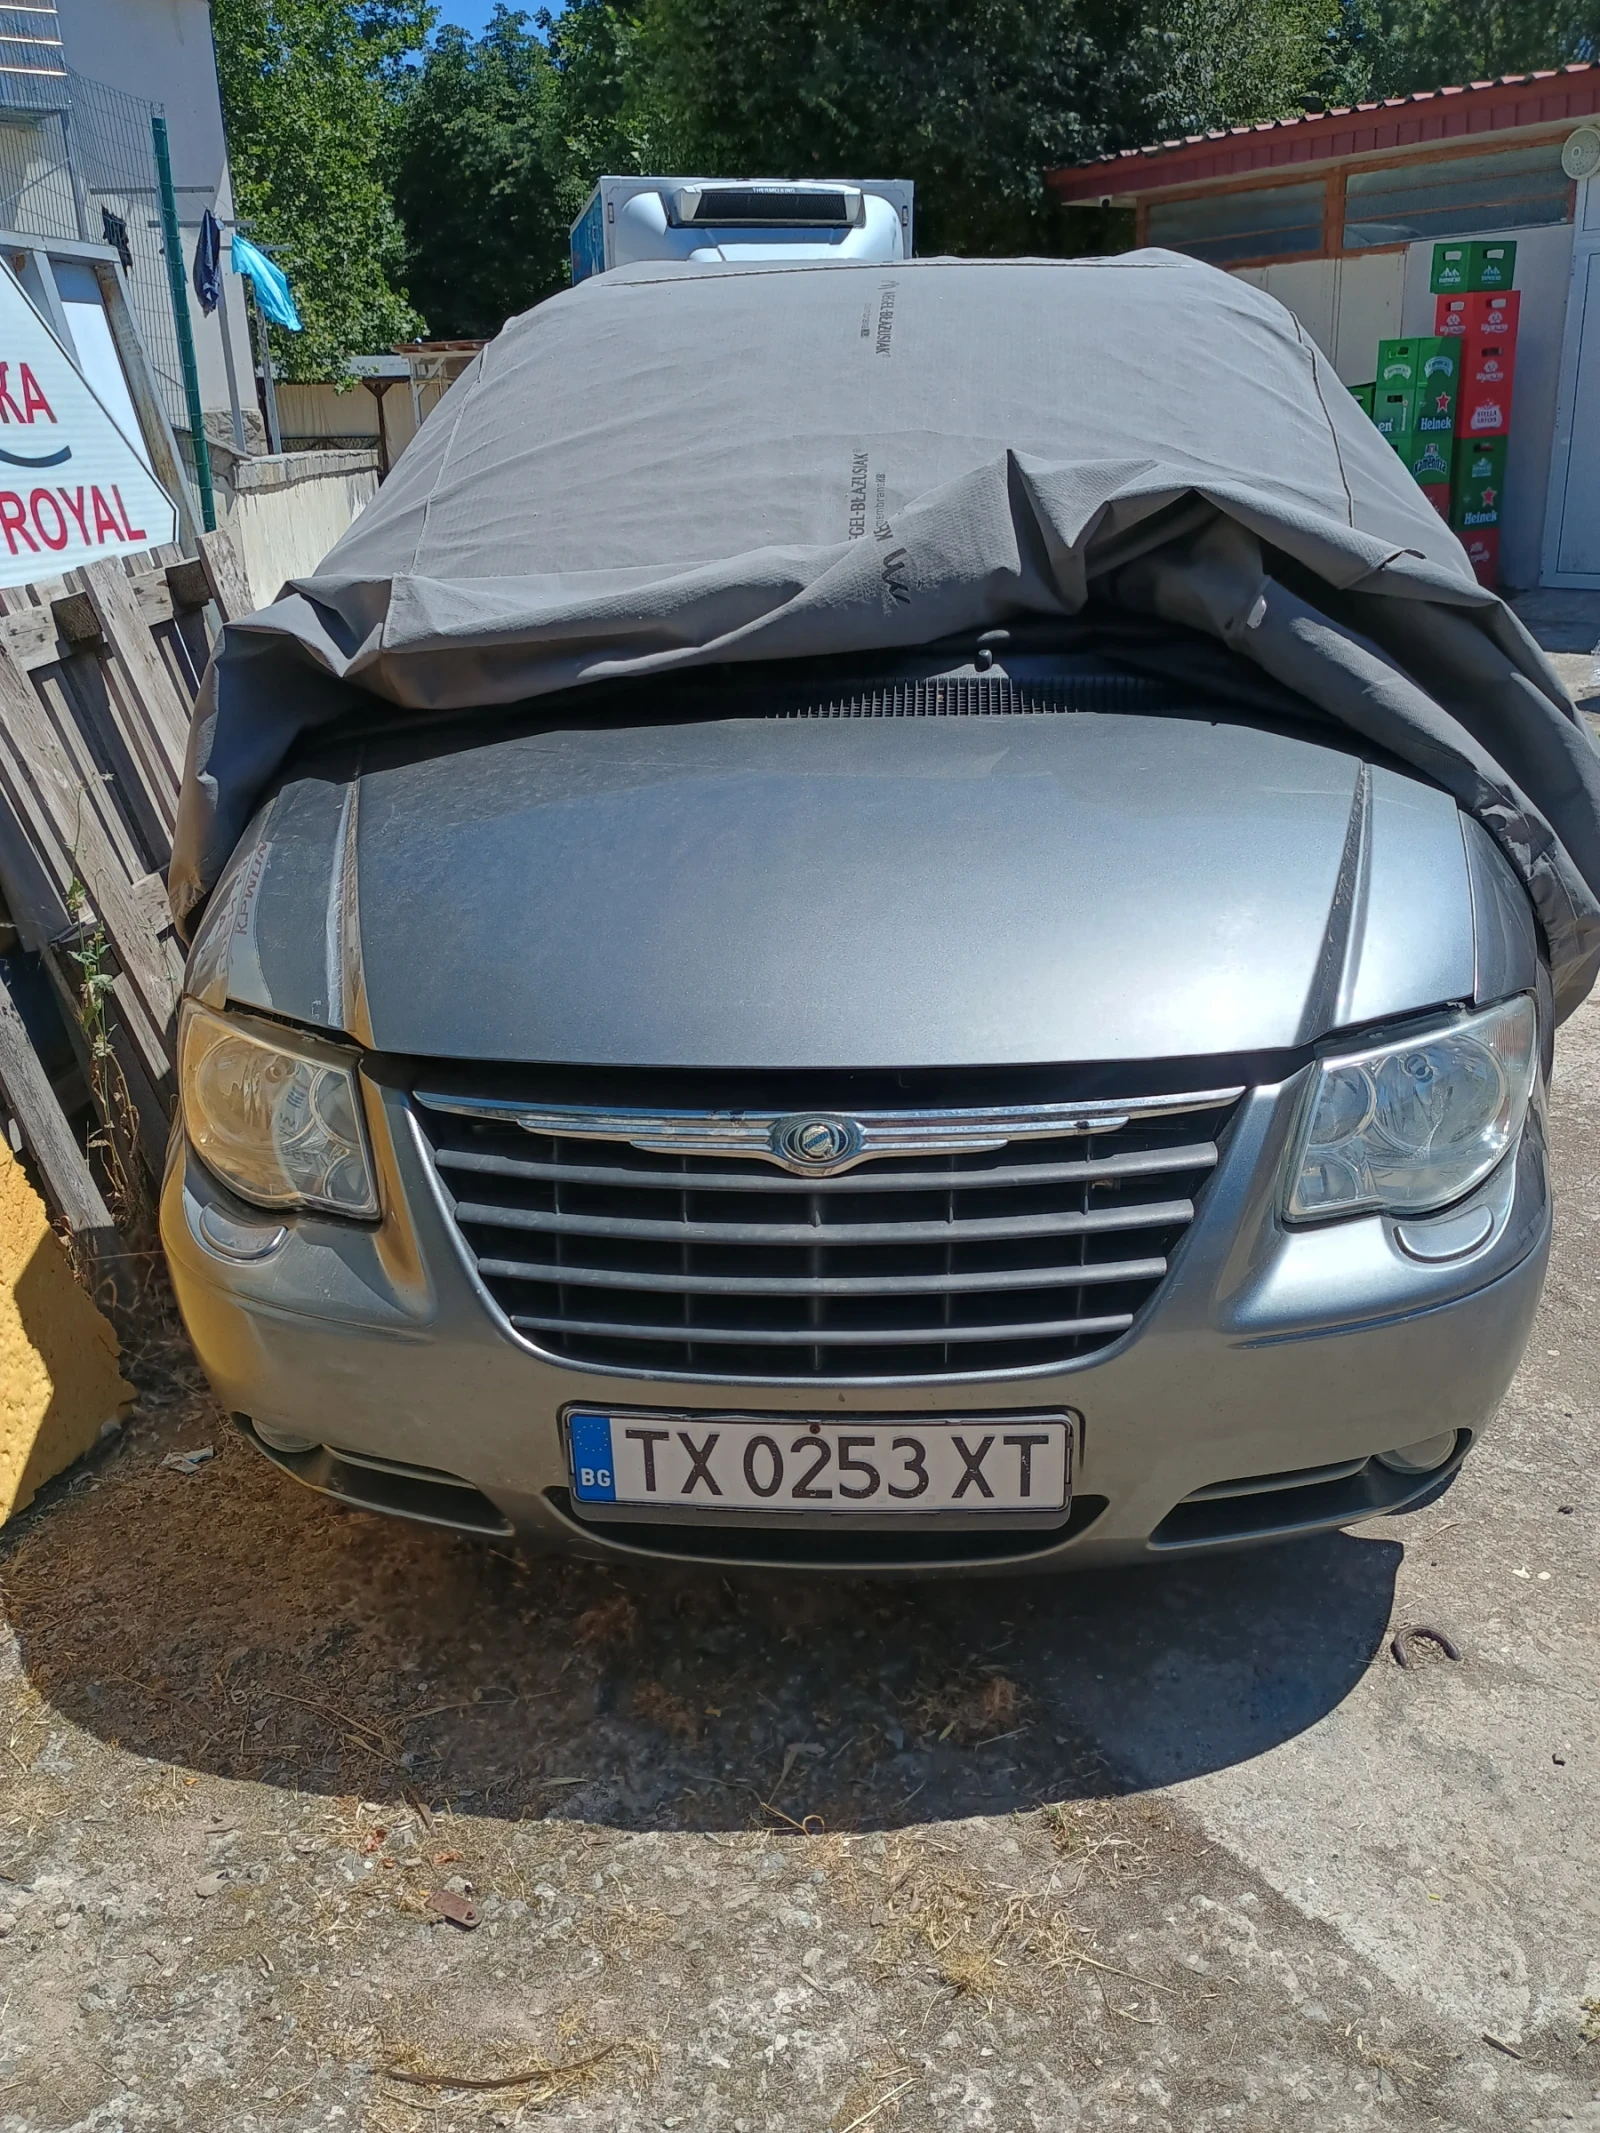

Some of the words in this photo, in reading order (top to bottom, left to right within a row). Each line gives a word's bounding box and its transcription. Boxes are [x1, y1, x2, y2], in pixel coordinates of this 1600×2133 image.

[0, 484, 147, 555] ROYAL
[580, 1467, 611, 1487] BG
[625, 1429, 723, 1496] TX
[743, 1435, 930, 1500] 0253
[951, 1436, 1050, 1499] XT
